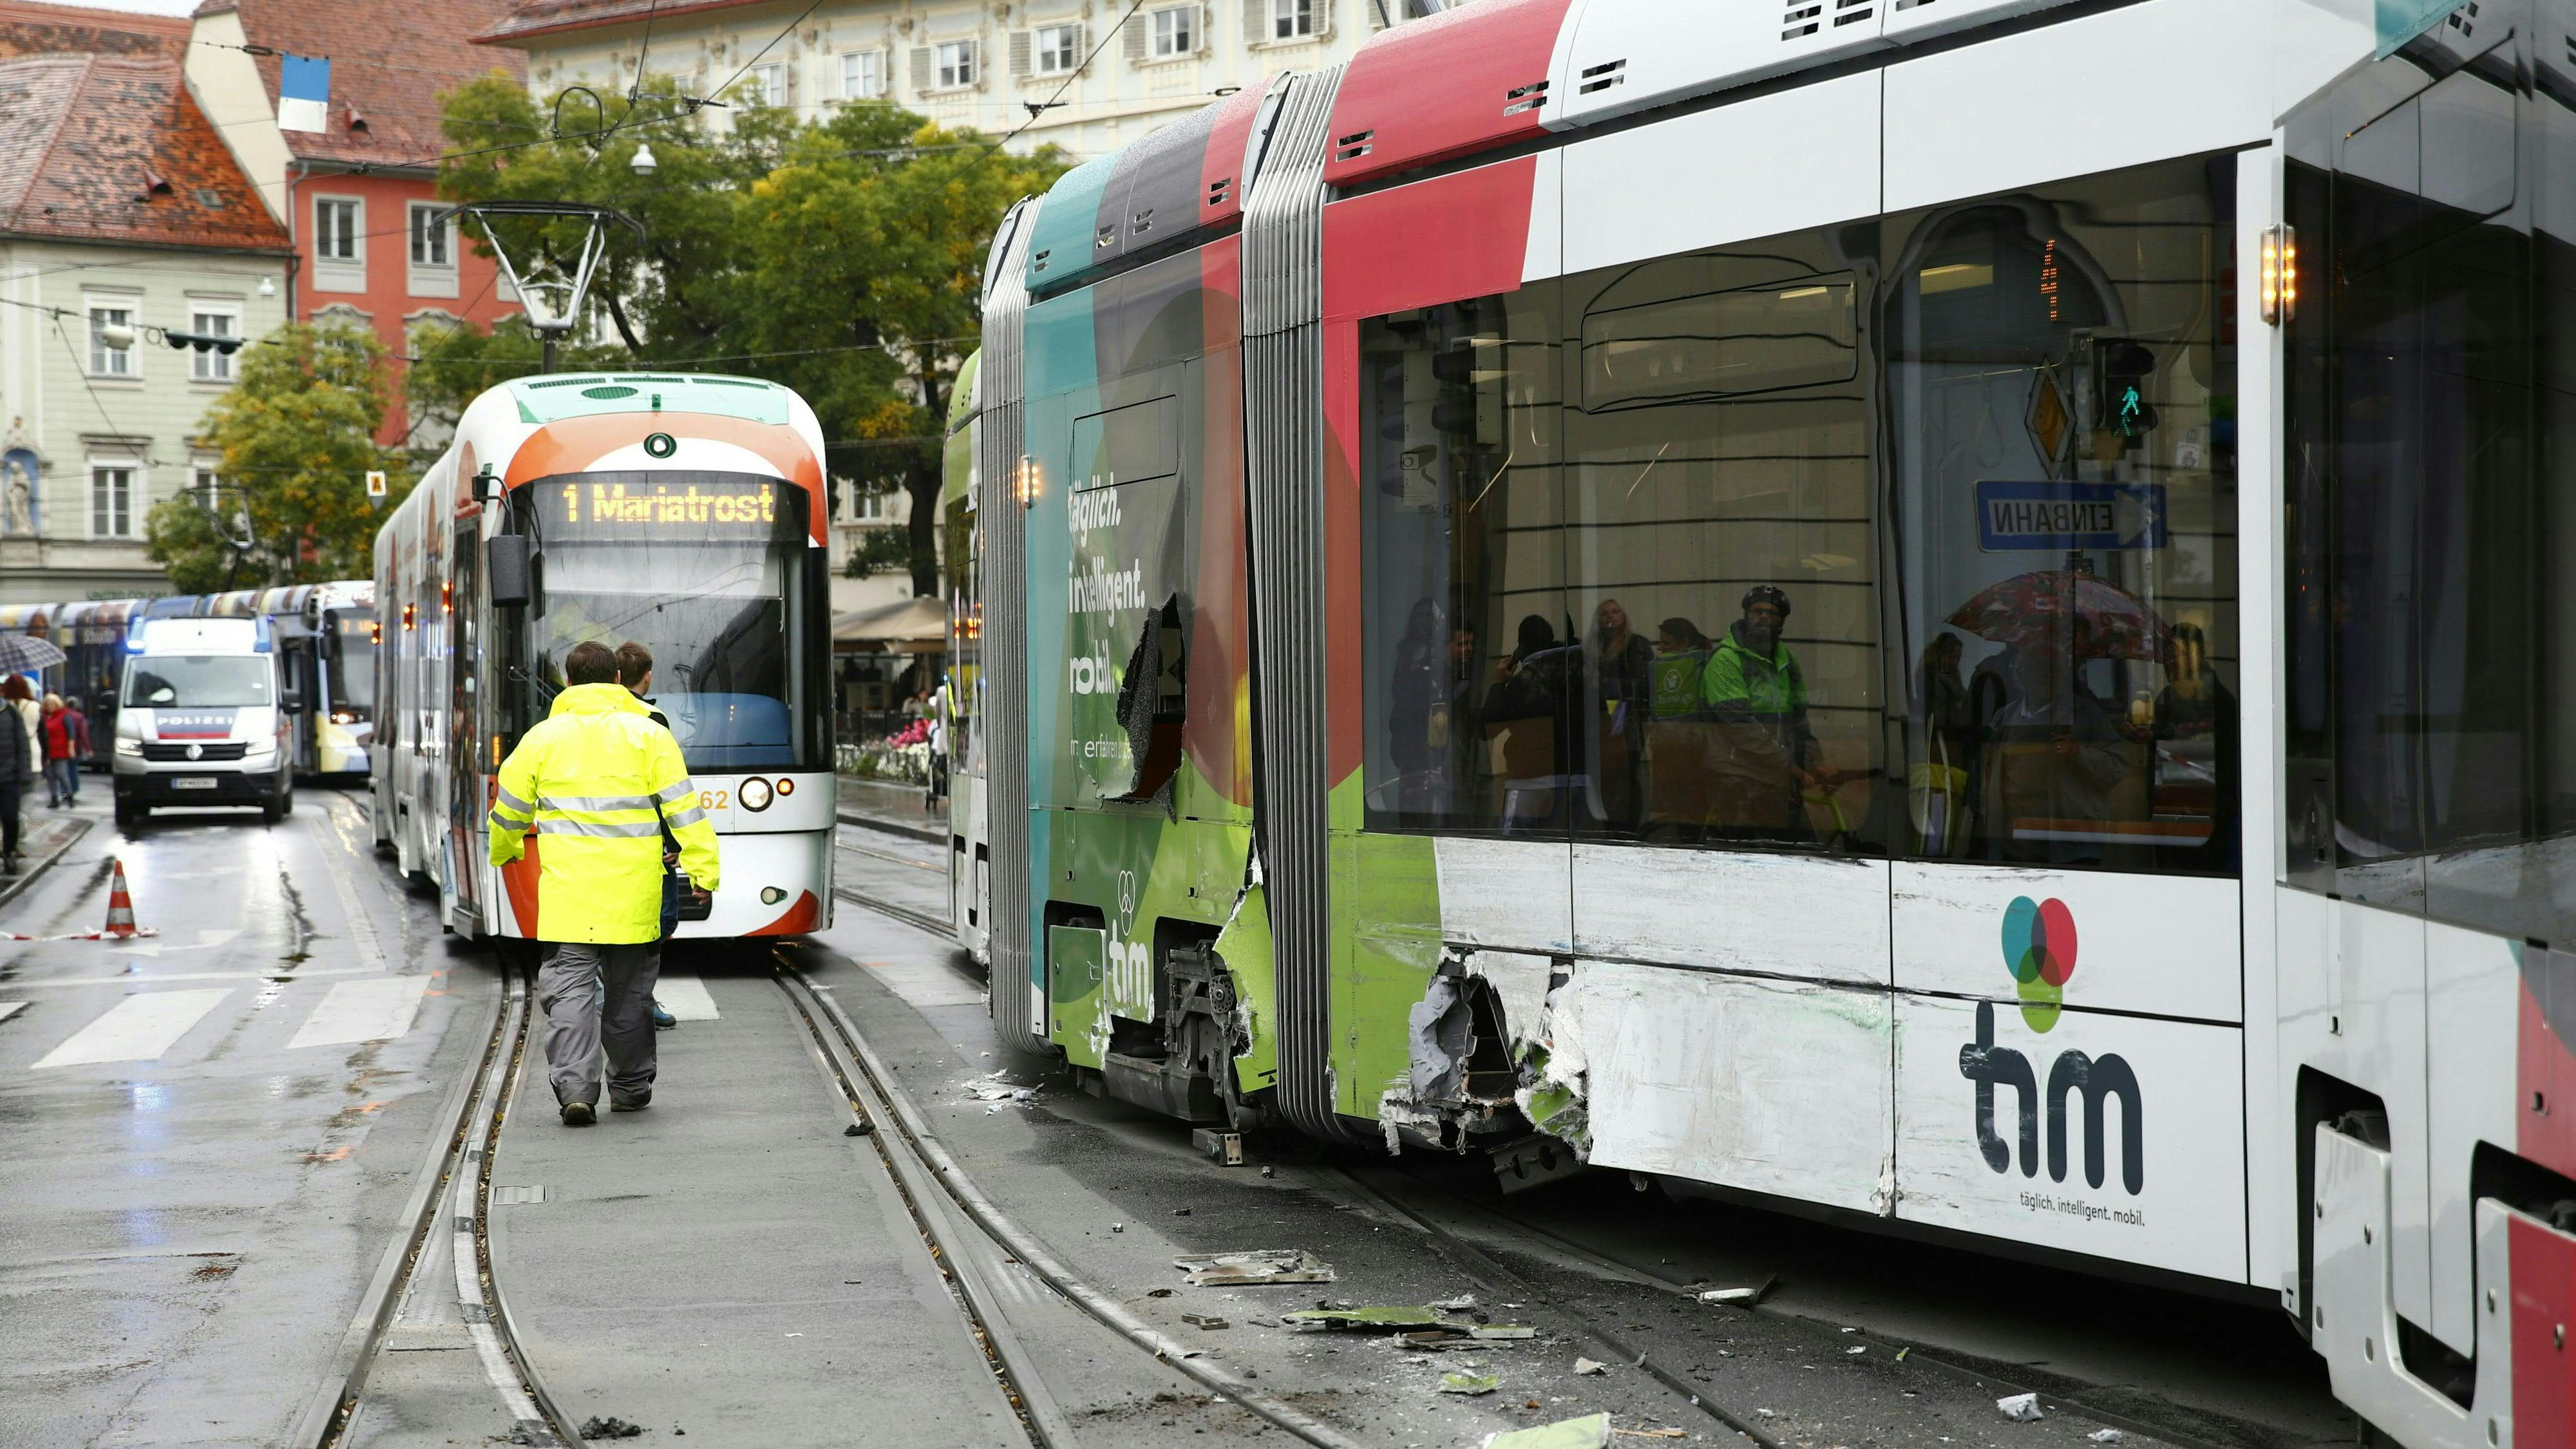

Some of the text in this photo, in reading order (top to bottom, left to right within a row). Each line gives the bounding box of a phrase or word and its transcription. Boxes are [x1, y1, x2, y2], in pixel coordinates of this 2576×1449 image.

[563, 484, 774, 523] 1 Mariatrost
[1068, 471, 1121, 547] täglich.
[1068, 555, 1146, 629] intelligent.
[156, 715, 234, 726] POLIZEI
[2020, 1191, 2145, 1227] täglich. intelligent. mobil.
